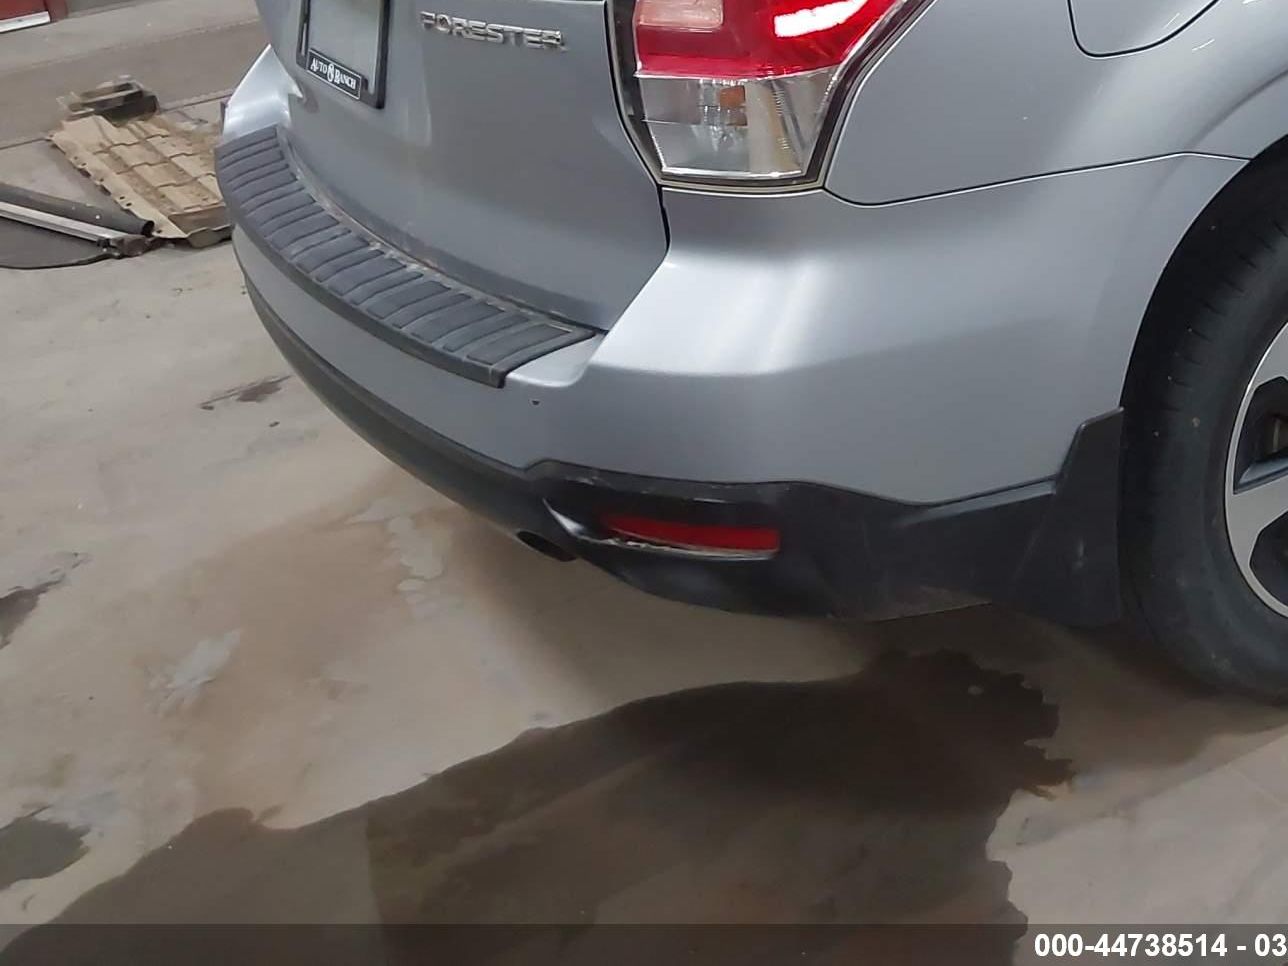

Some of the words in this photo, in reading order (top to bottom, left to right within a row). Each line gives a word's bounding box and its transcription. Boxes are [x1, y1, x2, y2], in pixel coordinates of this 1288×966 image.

[420, 10, 565, 49] FORESTER
[310, 57, 327, 74] AUTO
[334, 67, 357, 90] RANCH
